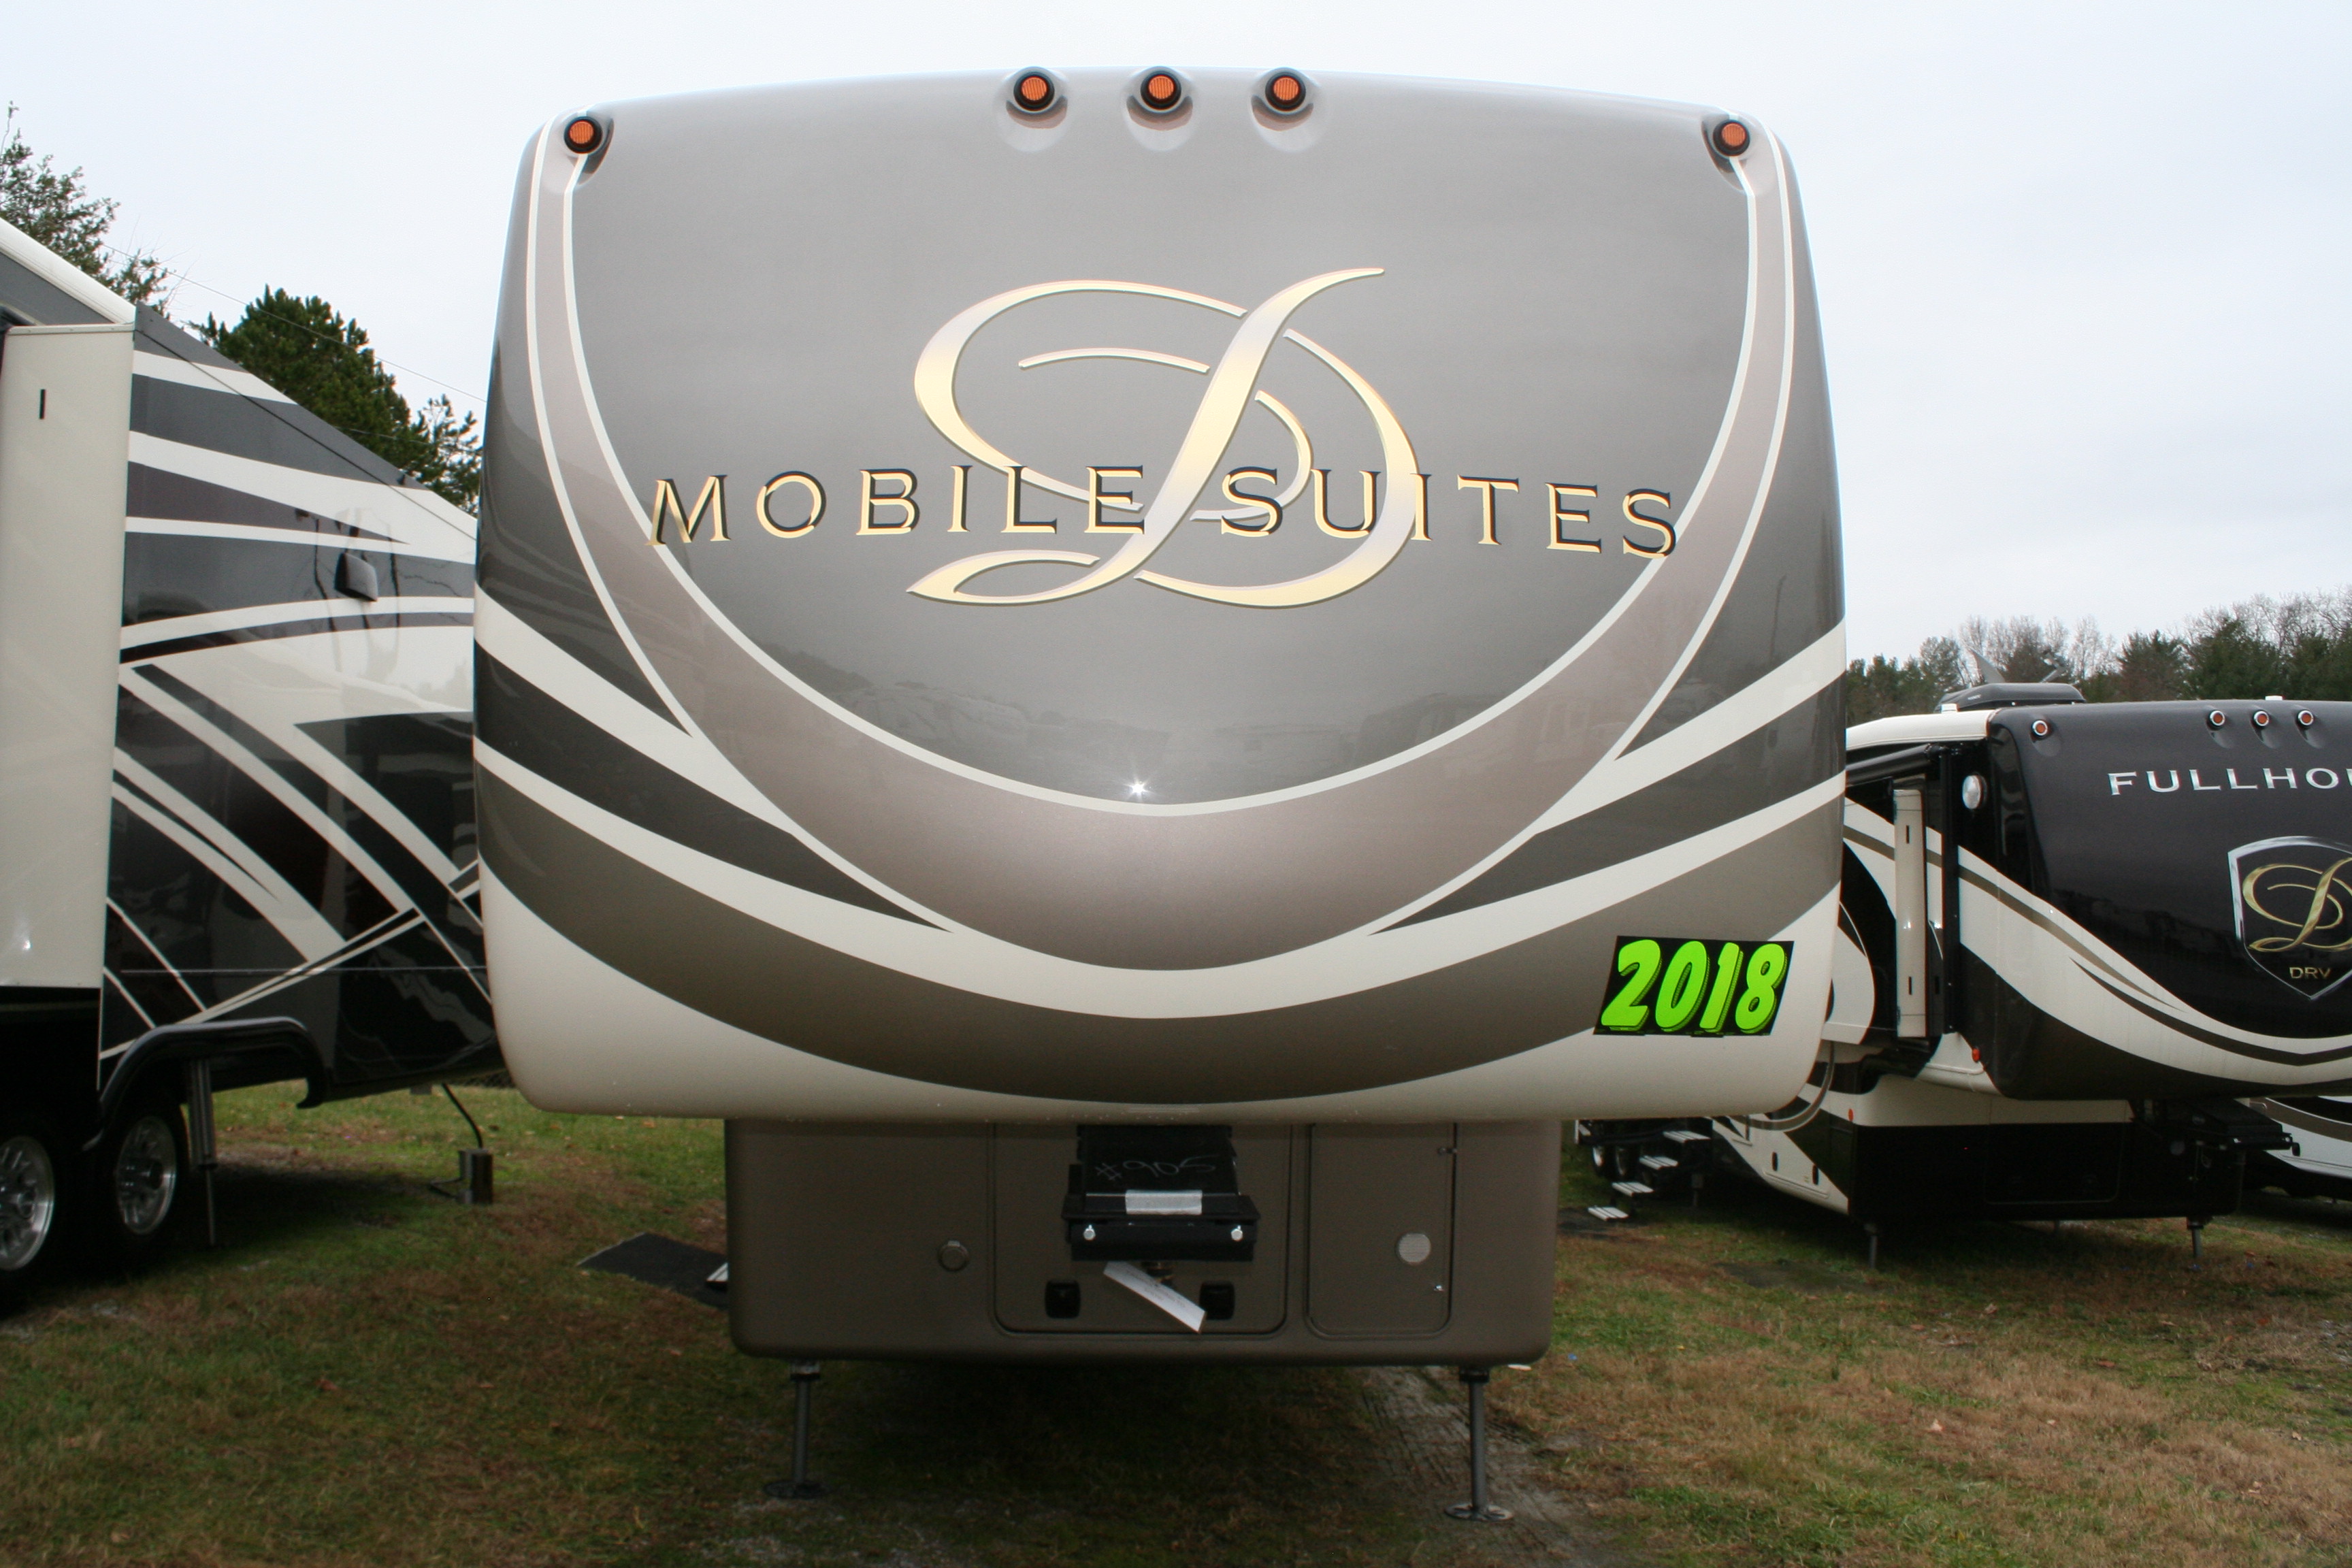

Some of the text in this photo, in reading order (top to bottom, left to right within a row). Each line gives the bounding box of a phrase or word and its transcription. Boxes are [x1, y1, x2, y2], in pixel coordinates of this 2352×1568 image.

[646, 465, 1677, 559] MOBILE SUITES
[2108, 767, 2352, 796] FULLHO
[1601, 939, 1788, 1033] 2018
[2289, 966, 2332, 979] DRV
